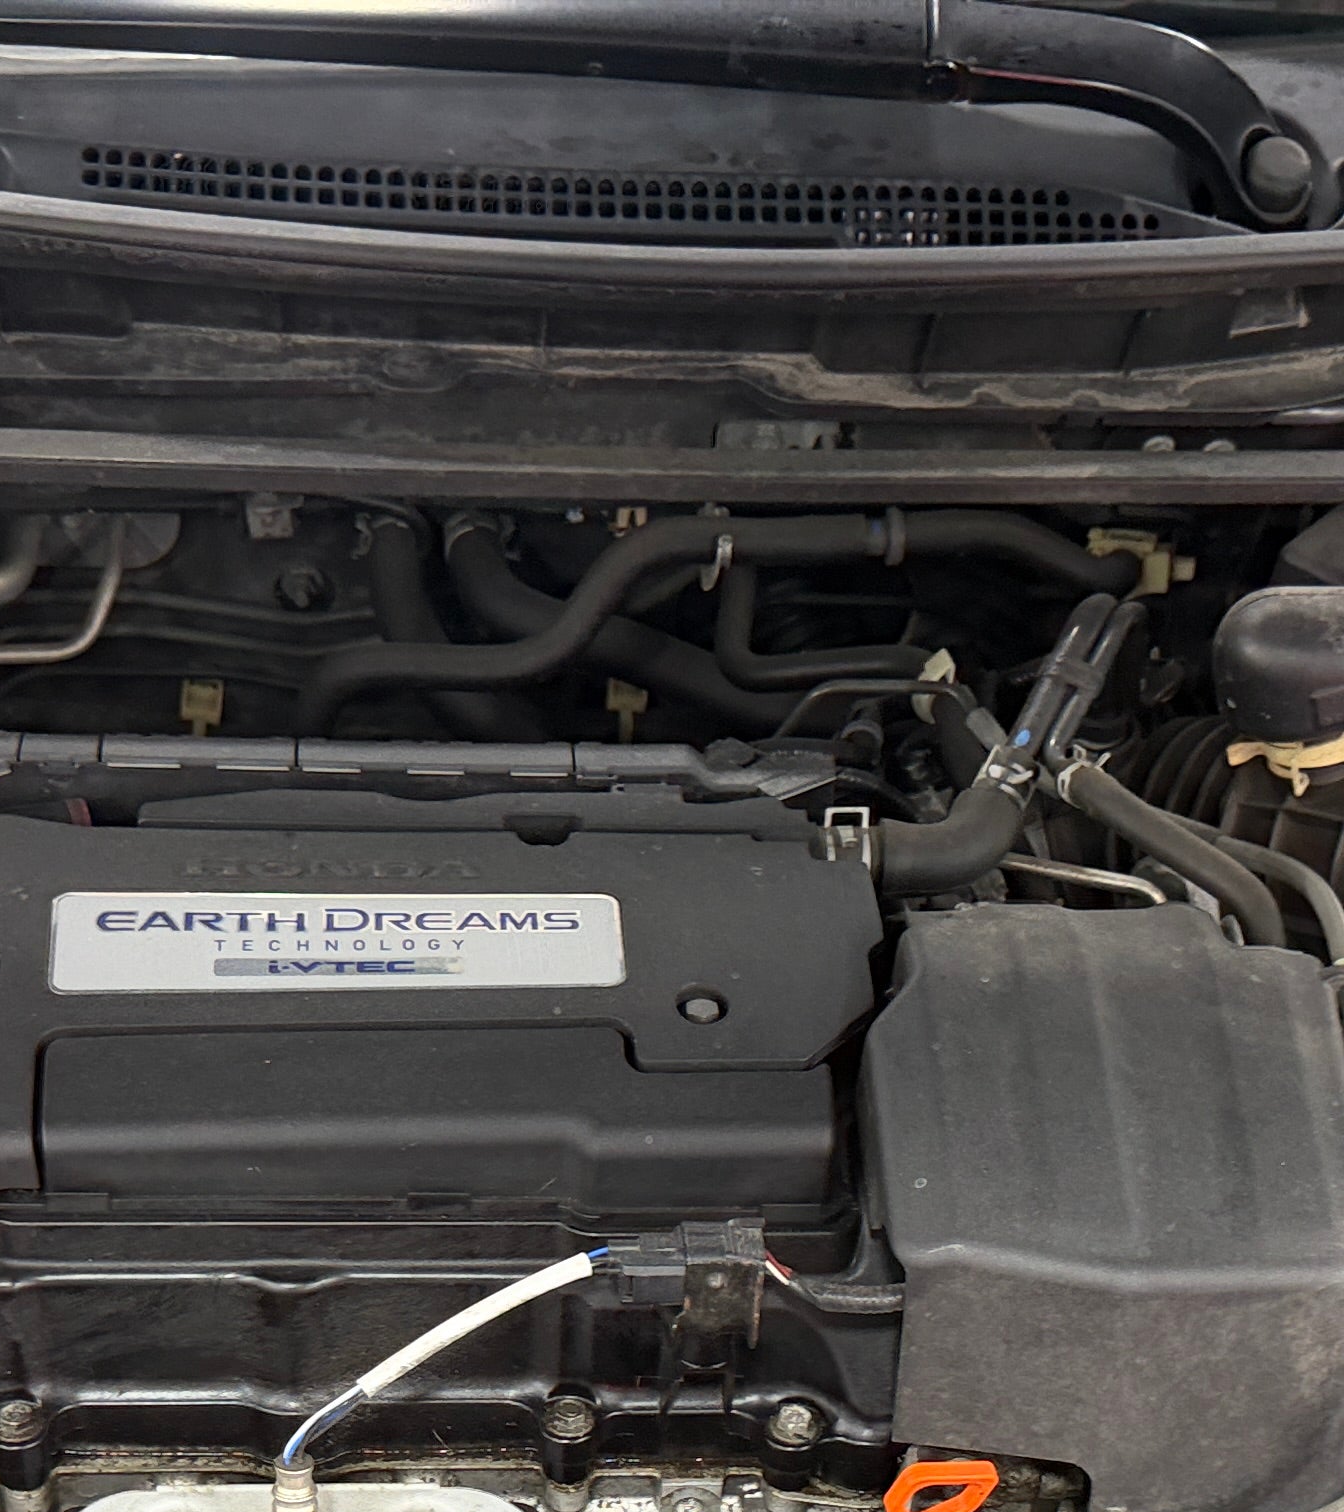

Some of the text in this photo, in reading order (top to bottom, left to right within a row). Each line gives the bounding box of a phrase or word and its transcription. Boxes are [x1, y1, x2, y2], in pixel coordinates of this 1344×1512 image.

[181, 857, 481, 880] HONDA
[96, 908, 581, 932] EARTH DREAMS
[213, 938, 466, 952] TECHNOLOGY
[268, 960, 415, 974] i-VTEC
